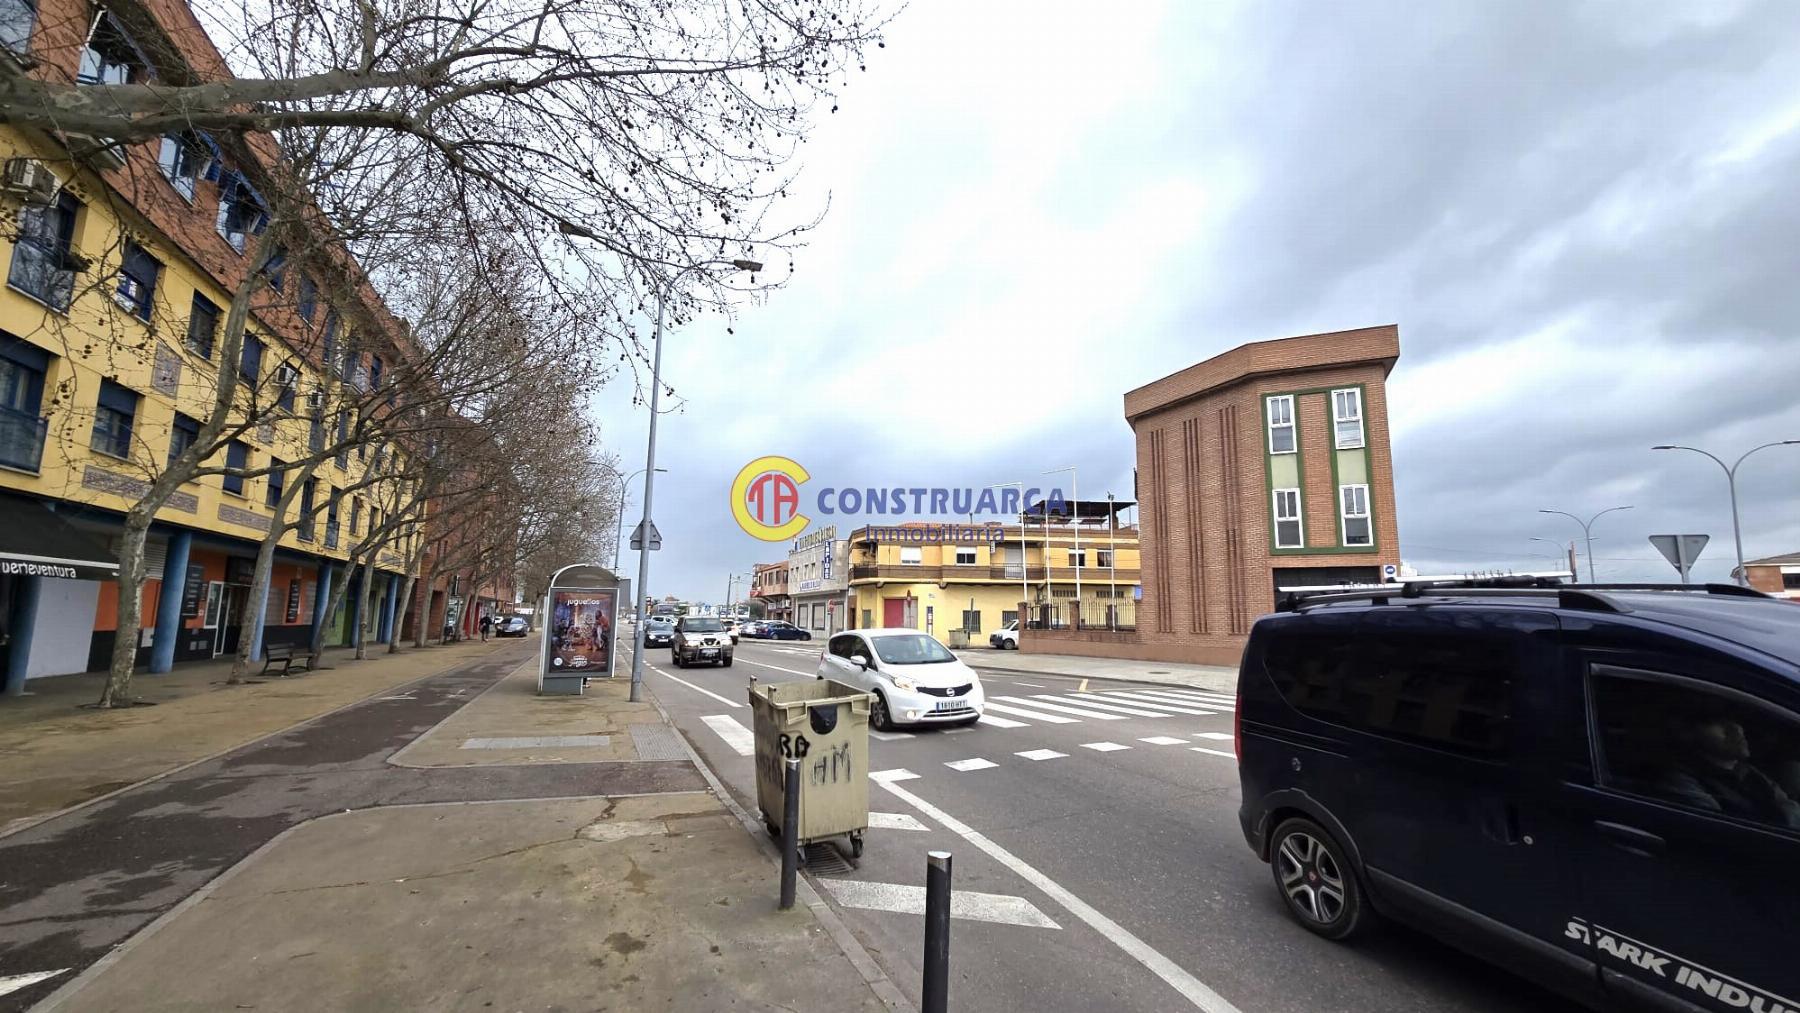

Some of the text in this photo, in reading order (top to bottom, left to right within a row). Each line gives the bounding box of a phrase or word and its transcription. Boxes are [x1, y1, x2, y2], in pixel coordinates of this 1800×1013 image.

[0, 562, 77, 578] uerteventura
[1565, 921, 1800, 1013] STARK INDU
